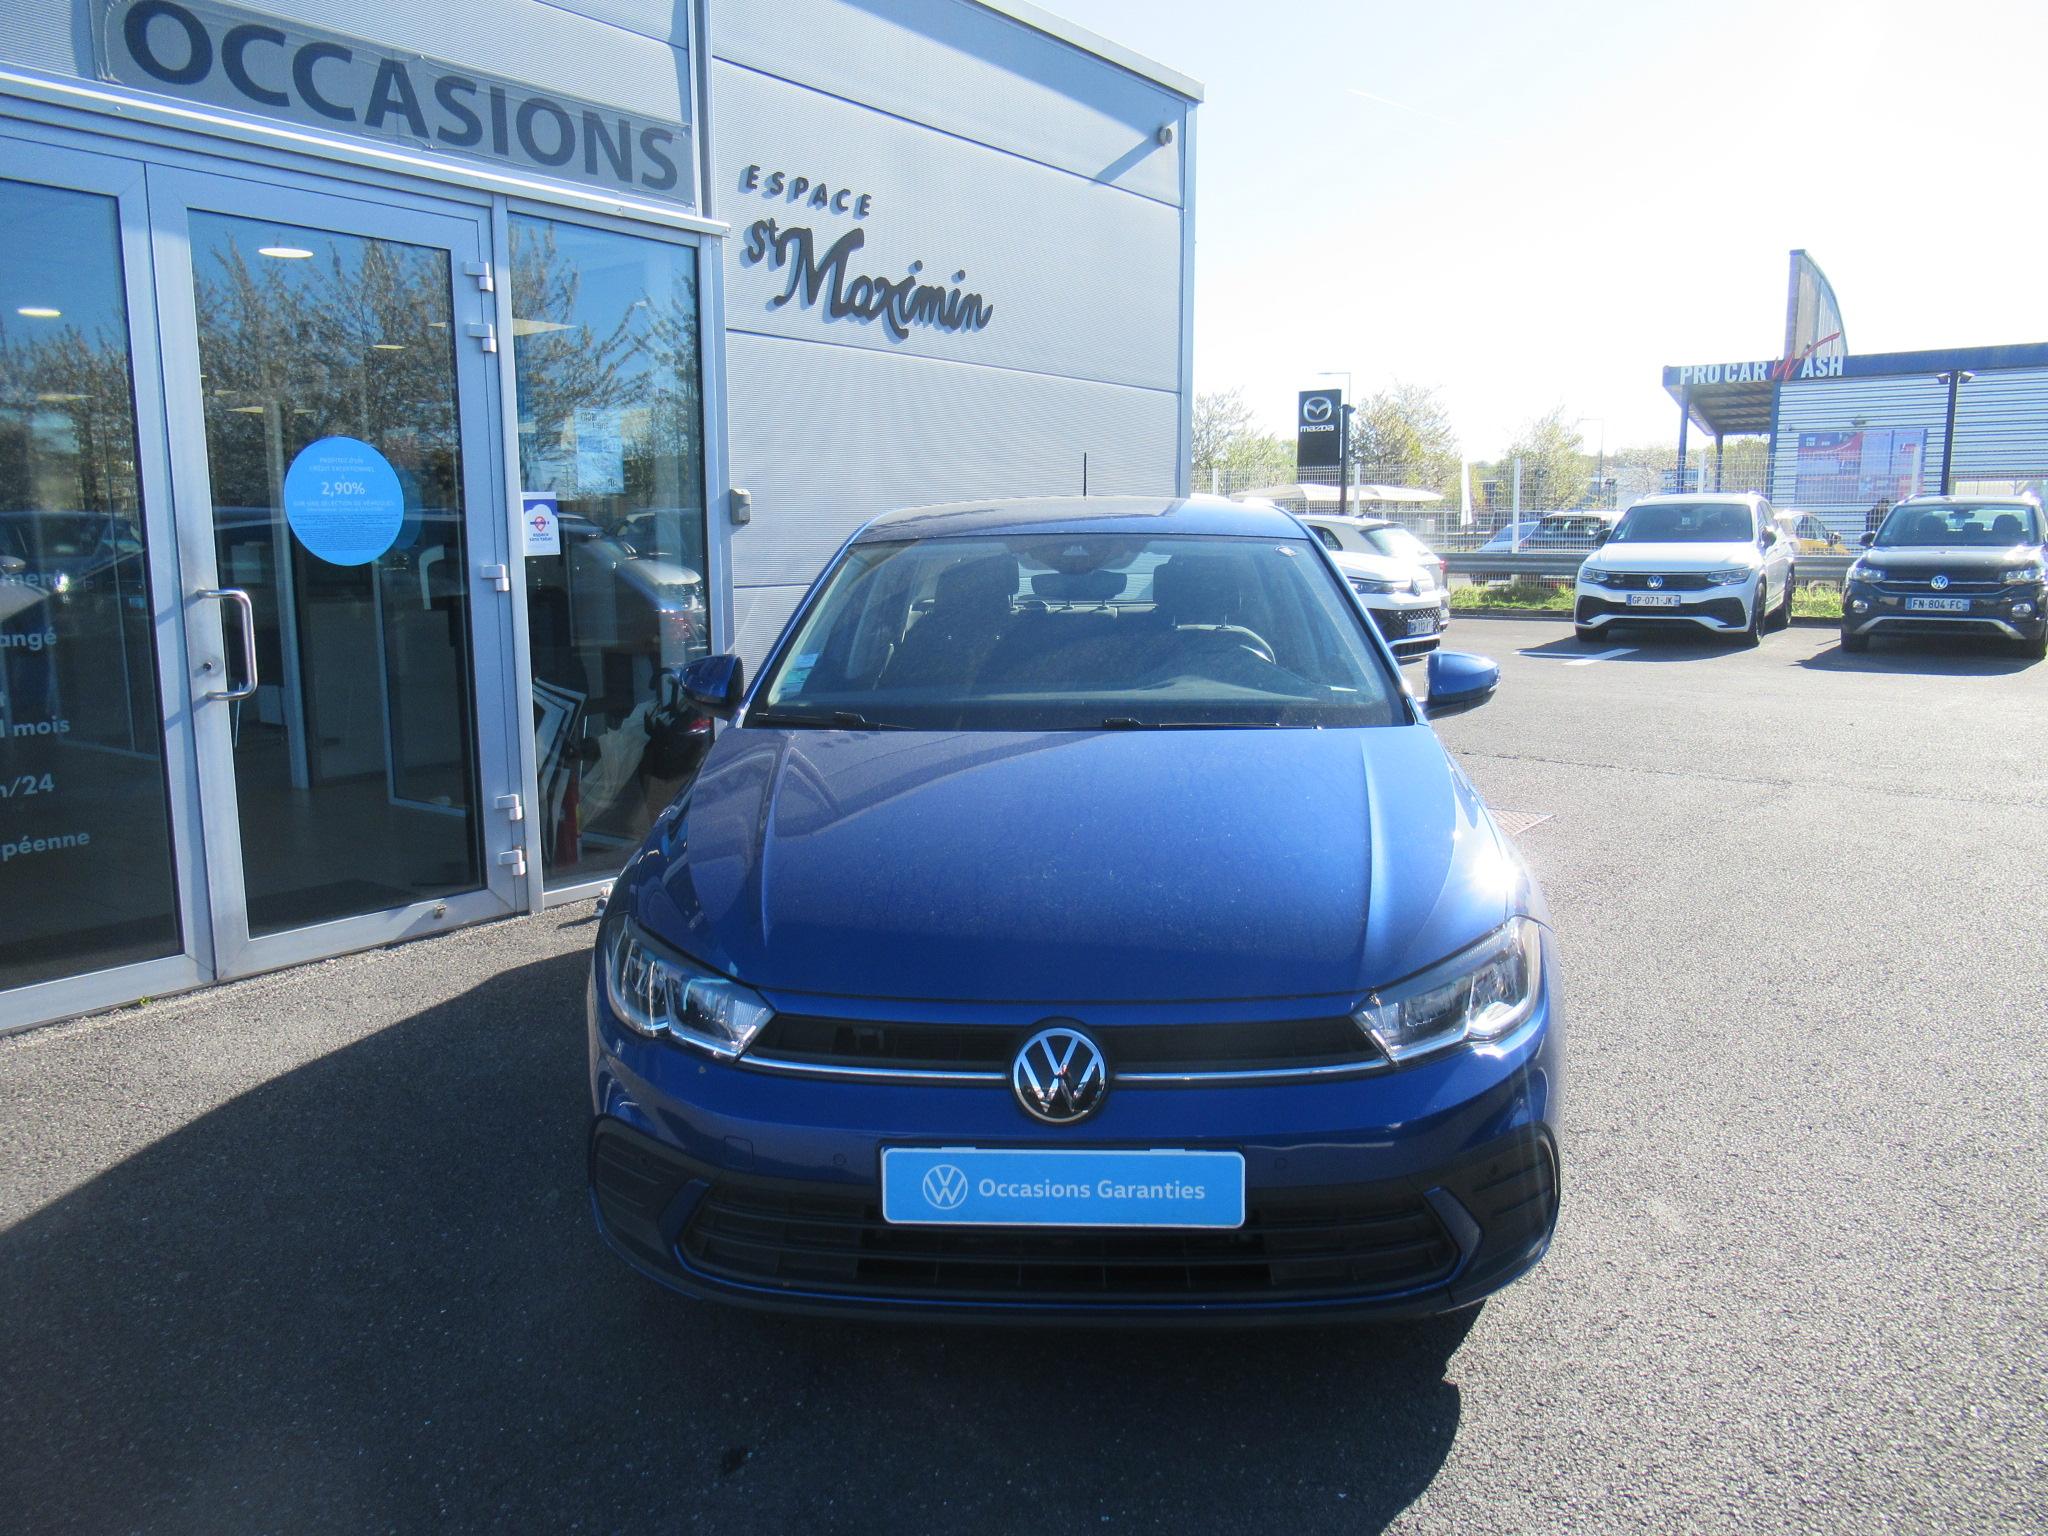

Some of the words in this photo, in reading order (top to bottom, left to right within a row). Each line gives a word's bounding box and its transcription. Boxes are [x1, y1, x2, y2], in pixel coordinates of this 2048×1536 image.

[123, 0, 678, 190] OCCASIONS
[746, 164, 872, 217] ESPACE
[773, 227, 993, 340] Maximin
[1680, 364, 1720, 385] PRO
[1724, 361, 1767, 383] CAR
[321, 481, 366, 497] 2,90%
[1912, 599, 1962, 610] FN-804-FC
[13, 715, 71, 737] mois
[978, 1177, 1091, 1199] Occasions
[1096, 1178, 1206, 1201] Garanties
